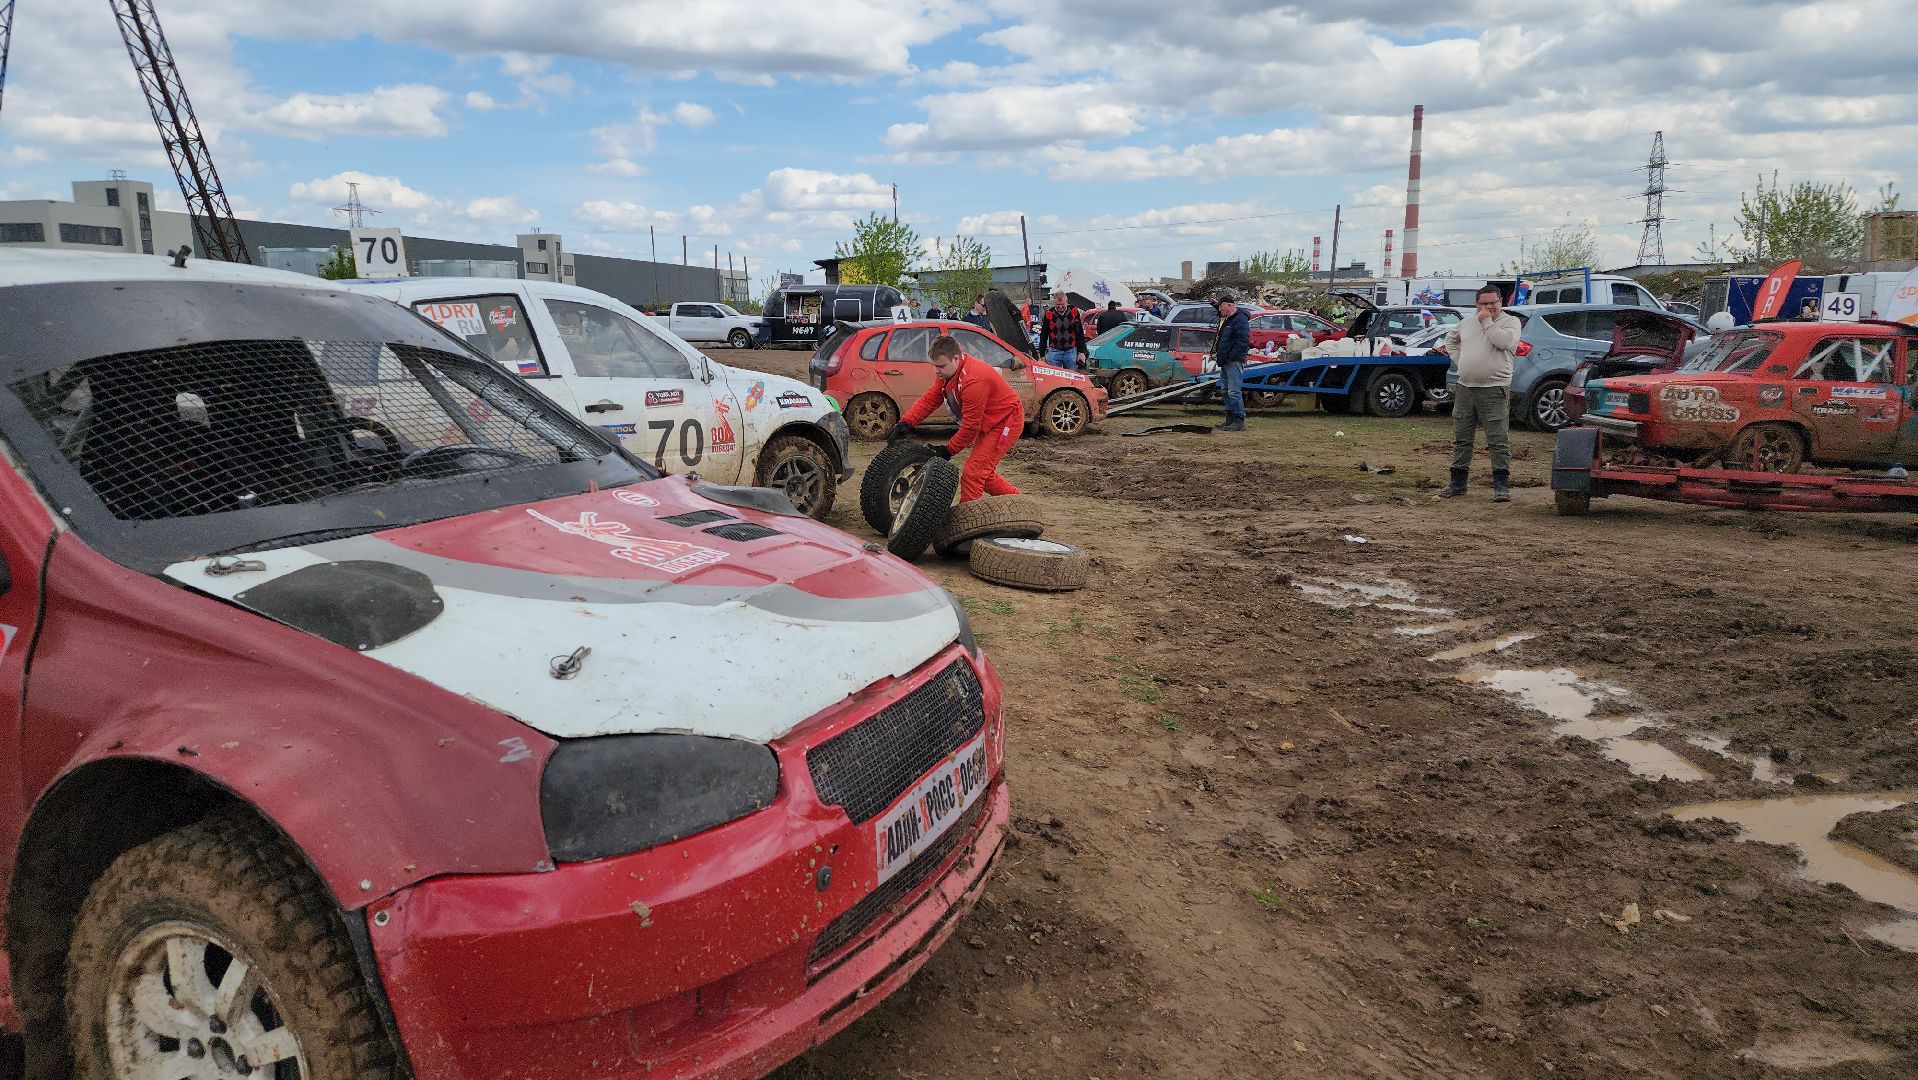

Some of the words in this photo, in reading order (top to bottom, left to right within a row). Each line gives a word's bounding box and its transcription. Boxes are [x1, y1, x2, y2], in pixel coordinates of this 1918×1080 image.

[359, 236, 399, 265] 70
[896, 308, 909, 322] 4
[1828, 297, 1855, 316] 49
[458, 319, 483, 334] RU
[778, 397, 809, 406] KRAMAR
[648, 418, 704, 470] 70
